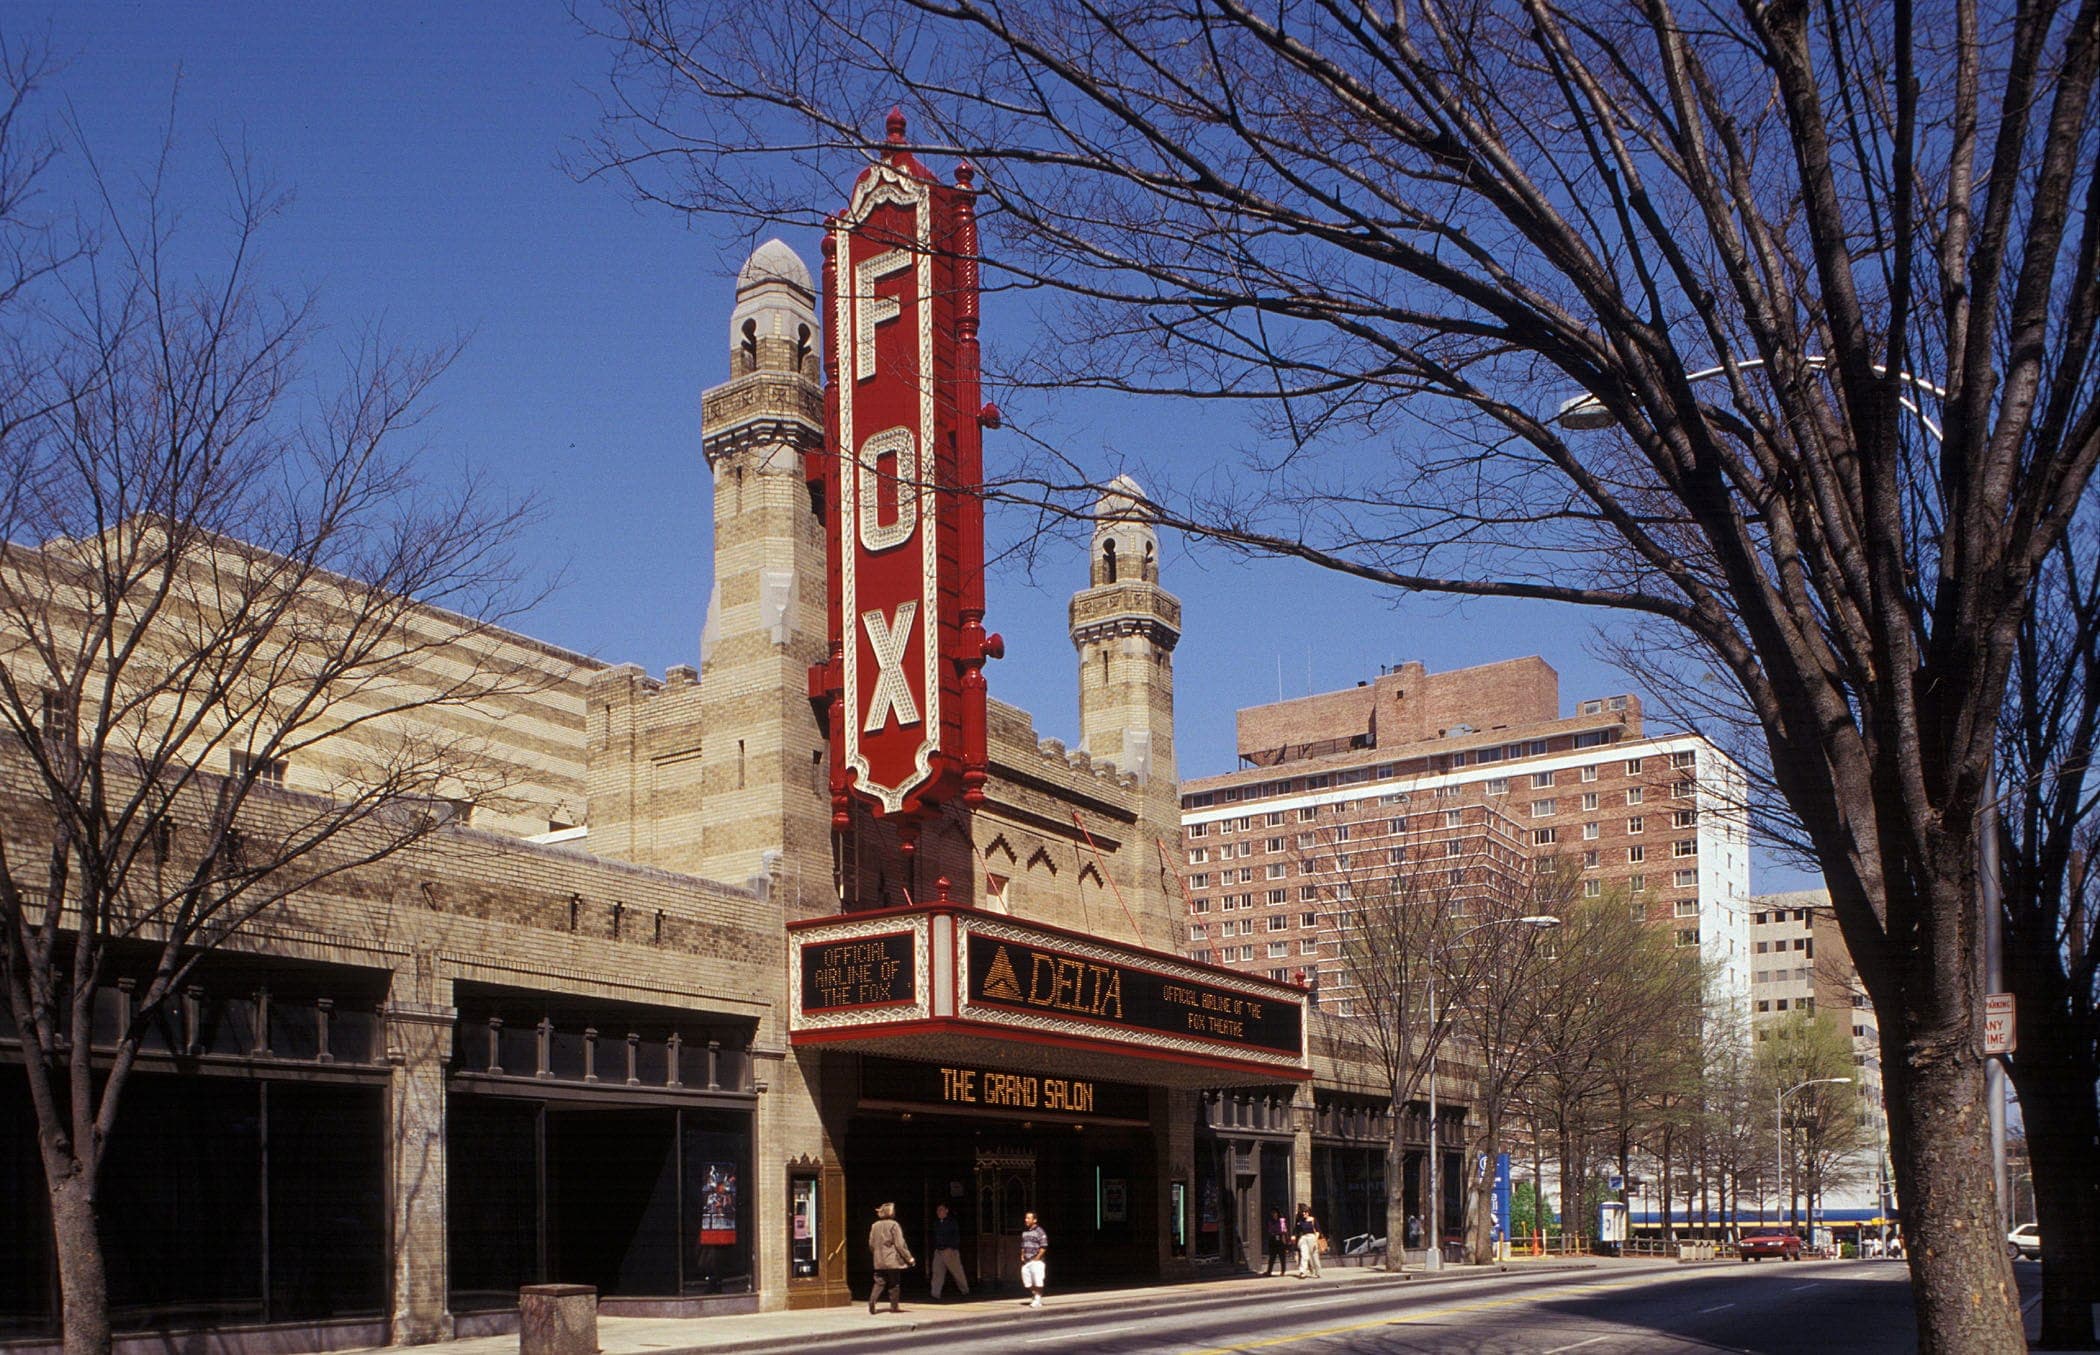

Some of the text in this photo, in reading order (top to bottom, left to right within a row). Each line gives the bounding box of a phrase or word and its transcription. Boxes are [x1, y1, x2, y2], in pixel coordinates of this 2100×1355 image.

[855, 245, 921, 733] FOX
[824, 942, 890, 966] OFFICIAL
[815, 960, 900, 988] AIRLINE OF
[1028, 952, 1123, 1019] DELTA
[821, 982, 891, 1006] THE FOX
[1162, 984, 1262, 1019] OFFICIAL AIRLINE OF THE
[1188, 1012, 1244, 1037] FOX THEATRE
[1986, 1033, 2006, 1045] IME
[940, 1068, 1094, 1112] THE GRAND SALON
